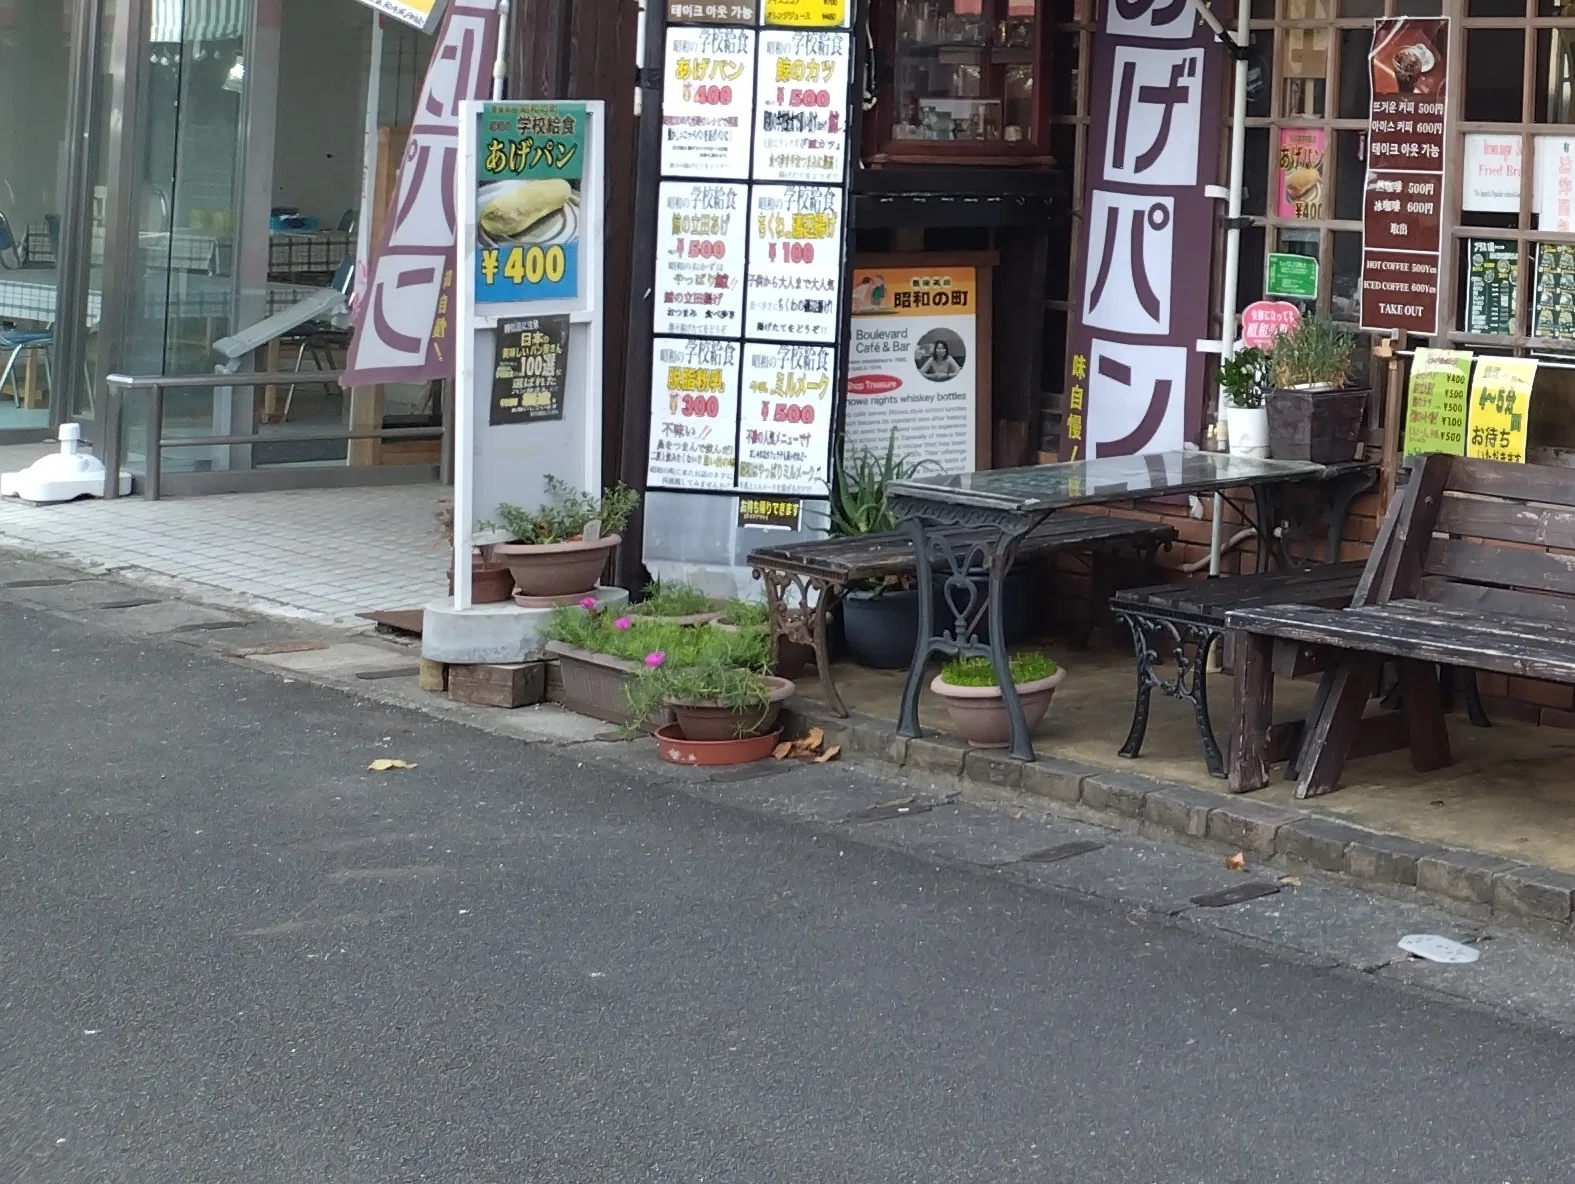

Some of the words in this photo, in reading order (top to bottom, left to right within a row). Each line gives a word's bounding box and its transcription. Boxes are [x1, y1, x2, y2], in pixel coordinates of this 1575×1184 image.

[699, 29, 748, 54] 学校給食
[793, 31, 842, 56] 学校給食
[675, 57, 745, 81] あげパン
[1373, 101, 1397, 114] 뜨거운
[1399, 101, 1414, 114] 커피
[1418, 103, 1443, 115] 500円
[517, 114, 576, 135] 学校給食
[1397, 121, 1413, 134] 커피
[1417, 122, 1442, 135] 600円
[485, 136, 577, 176] あげパン
[1401, 144, 1419, 157] 아웃
[1421, 144, 1440, 158] 가능
[1478, 164, 1503, 177] Fried
[691, 186, 737, 210] 学校給食
[1408, 182, 1434, 195] 500円
[784, 186, 836, 211] 学校給食
[1407, 201, 1433, 214] 600円
[768, 242, 814, 263] ¥100
[481, 243, 566, 284] ¥400
[1366, 259, 1382, 269] HOT
[1382, 261, 1409, 272] COFFEE
[1411, 263, 1437, 274] 500Yen
[1363, 281, 1381, 290] ICED
[1382, 282, 1410, 292] COFFEE
[1411, 283, 1437, 294] 600Yen
[894, 290, 968, 308] 昭和の町
[1379, 303, 1403, 315] TAKE
[1404, 304, 1424, 317] OUT
[856, 327, 908, 341] Boulevard
[685, 339, 736, 366] 学校給食
[856, 341, 881, 353] Café
[893, 341, 911, 353] Bar
[777, 345, 829, 371] 学校給食
[669, 393, 719, 417] ¥300
[900, 393, 934, 406] whiskey
[937, 391, 967, 402] bottles
[761, 401, 815, 424] ¥500
